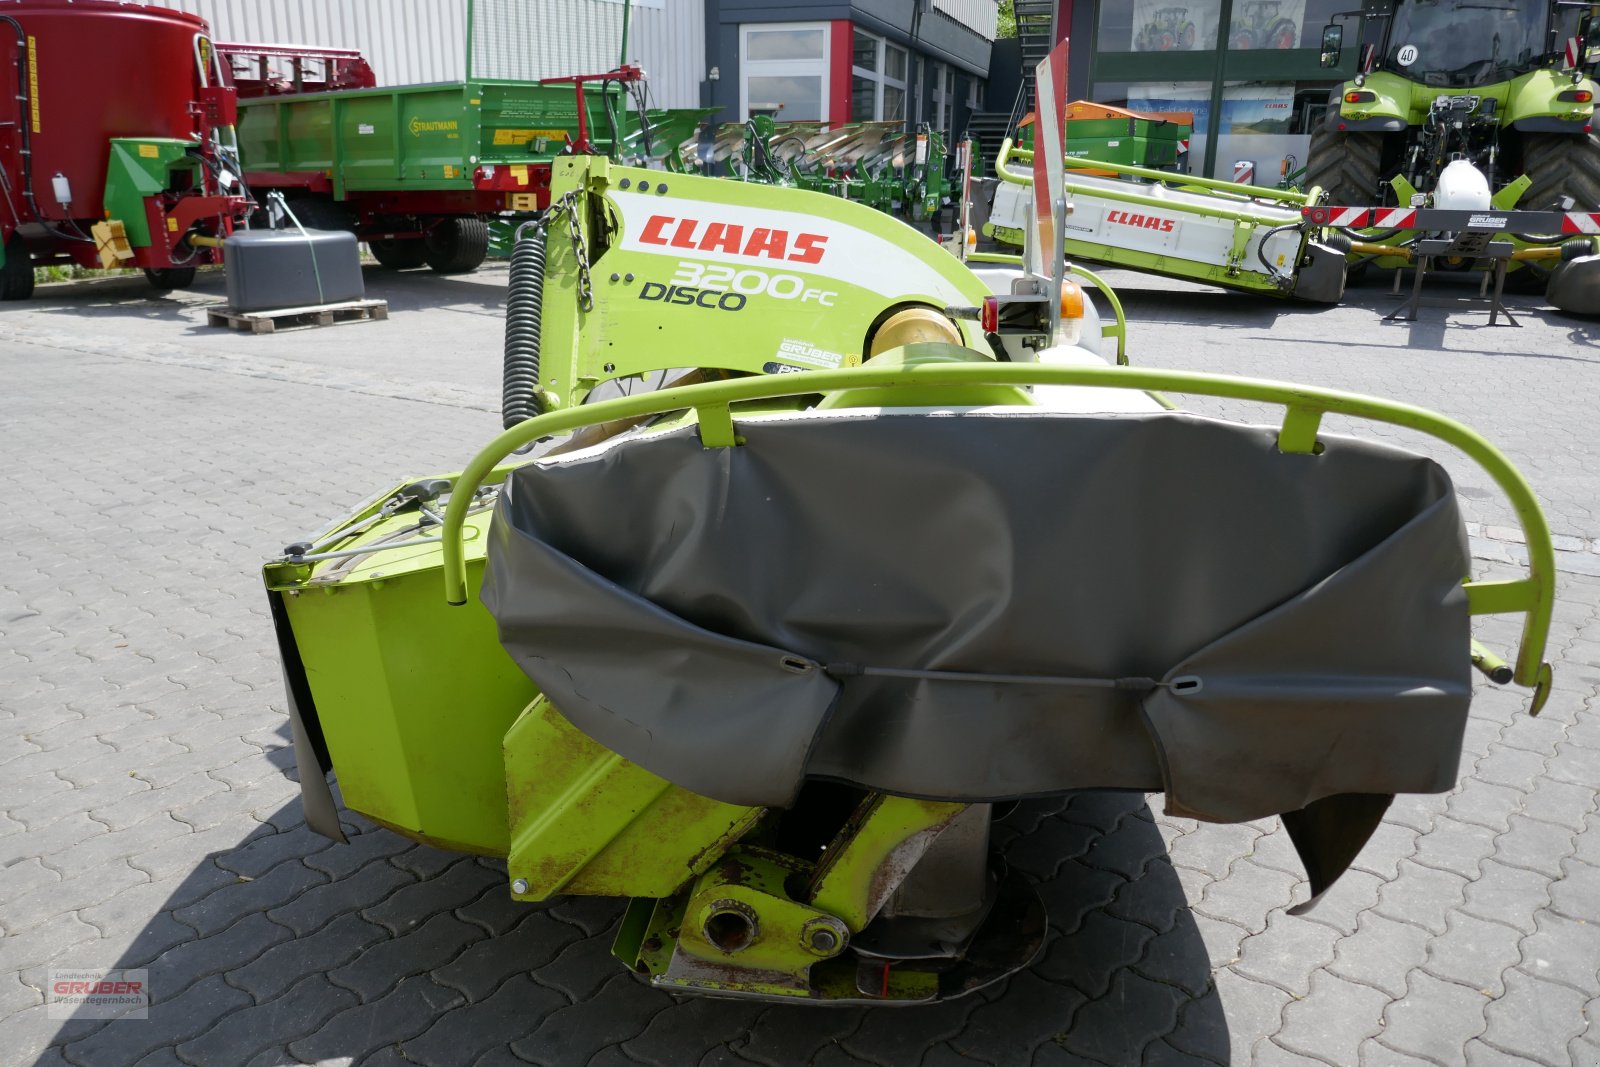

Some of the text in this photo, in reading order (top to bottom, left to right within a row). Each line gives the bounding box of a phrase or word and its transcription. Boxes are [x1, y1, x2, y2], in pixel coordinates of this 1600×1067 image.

[1400, 49, 1414, 61] 40
[413, 121, 458, 132] STRAUTMANN
[1107, 210, 1176, 232] CLAAS
[638, 214, 829, 265] CLAAS
[639, 282, 747, 311] DISCO
[780, 342, 842, 363] GRUBER
